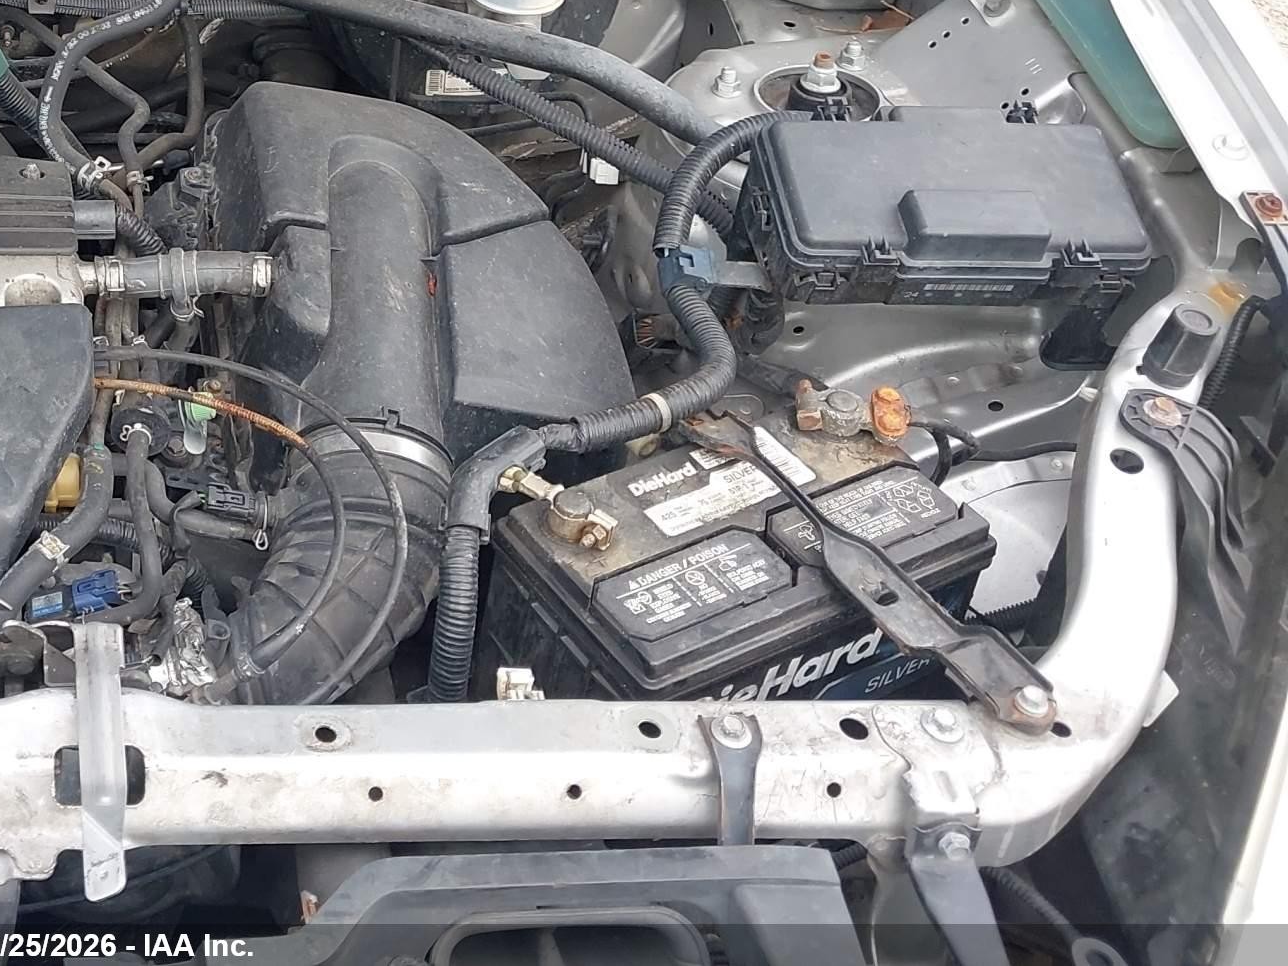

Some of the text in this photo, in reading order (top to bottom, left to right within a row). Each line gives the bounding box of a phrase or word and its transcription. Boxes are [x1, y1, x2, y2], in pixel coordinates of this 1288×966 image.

[627, 461, 697, 497] DieHard
[636, 562, 684, 587] DANGER
[688, 543, 730, 568] POISON
